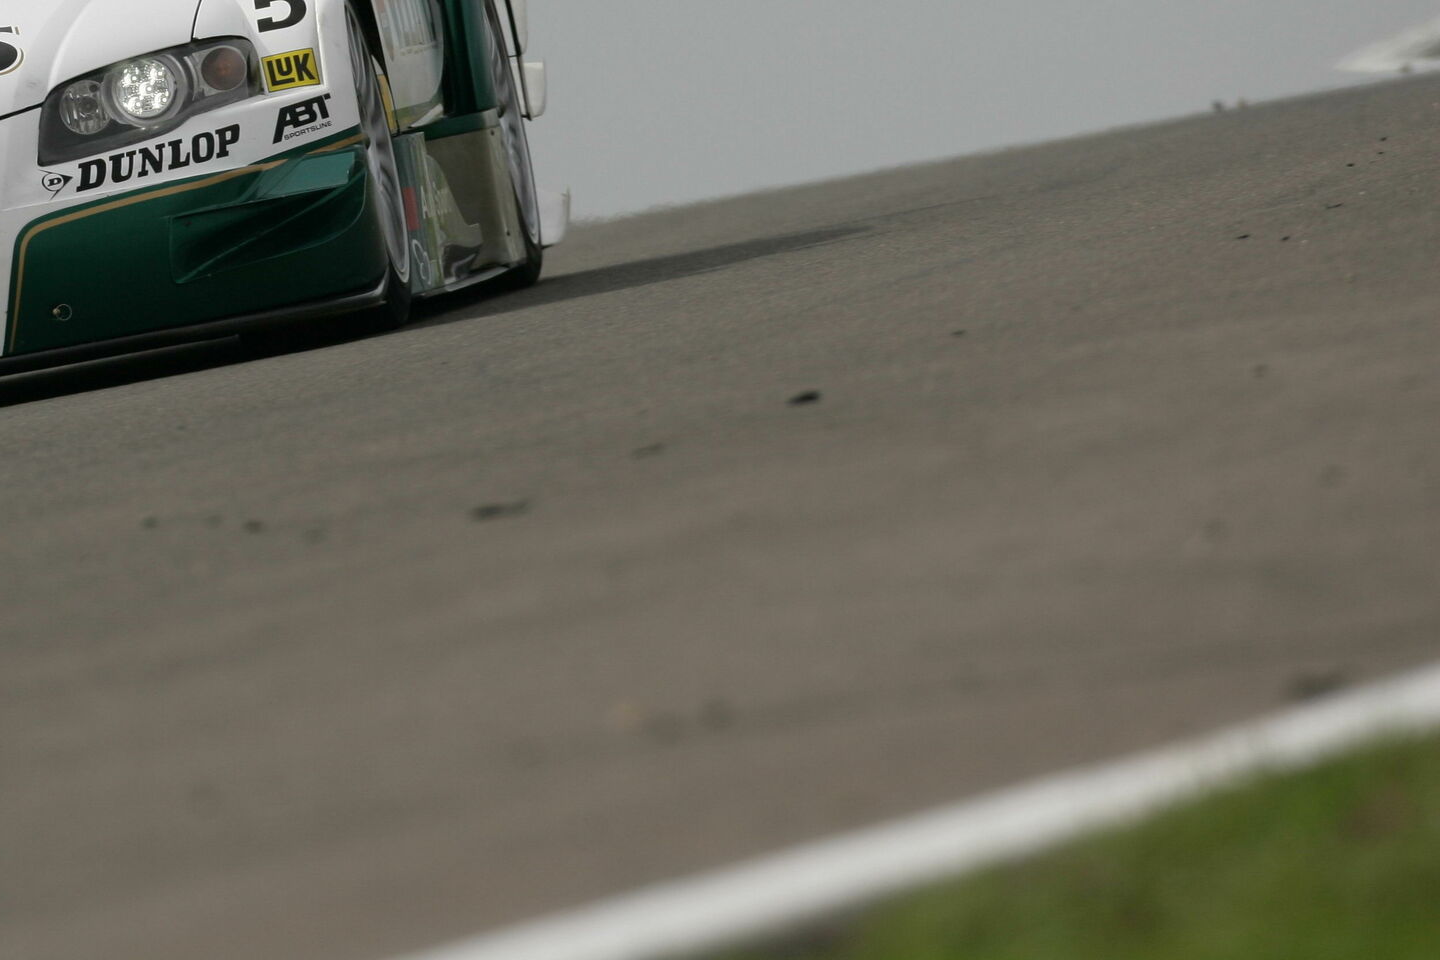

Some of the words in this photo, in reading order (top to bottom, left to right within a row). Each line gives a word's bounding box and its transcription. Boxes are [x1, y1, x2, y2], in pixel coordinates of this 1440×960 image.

[272, 93, 332, 144] ABT
[283, 120, 332, 141] SPORTSLINE
[76, 124, 240, 192] DUNLOP
